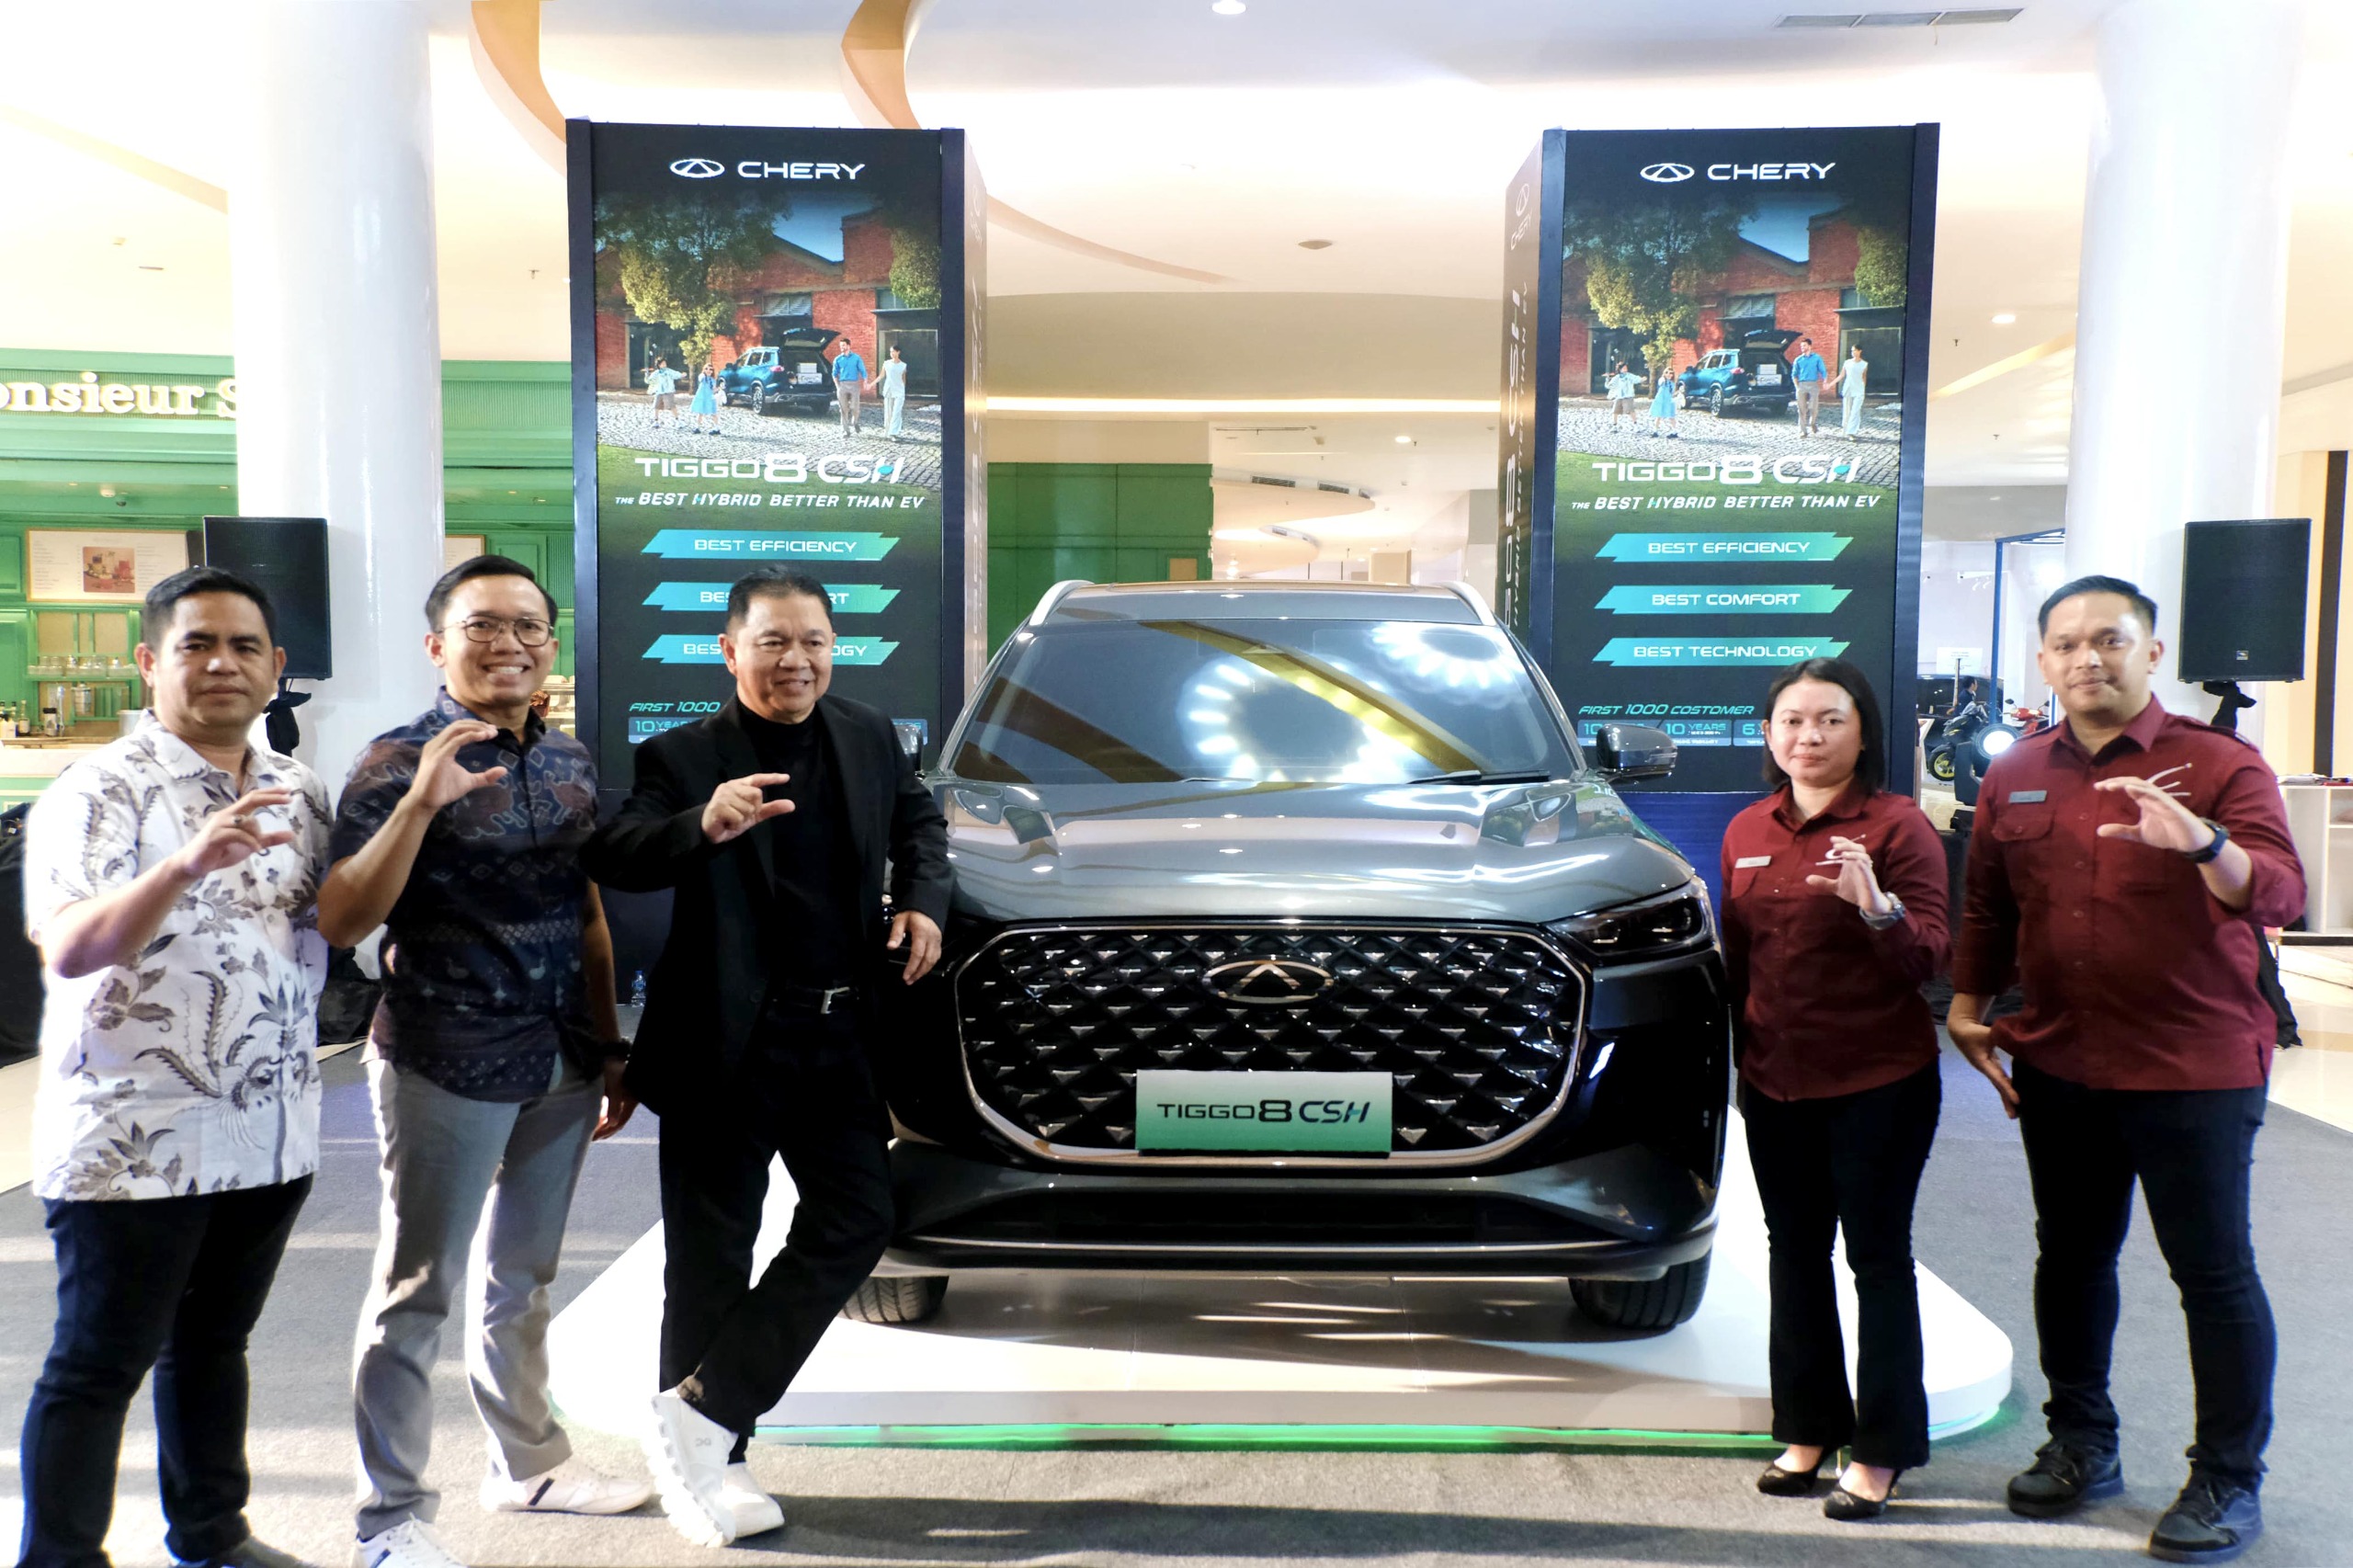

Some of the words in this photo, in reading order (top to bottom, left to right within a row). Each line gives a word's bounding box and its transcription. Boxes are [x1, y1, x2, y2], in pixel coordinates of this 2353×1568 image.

[737, 161, 866, 180] CHERY
[1707, 162, 1836, 180] CHERY
[1522, 281, 1528, 314] EV
[1508, 289, 1520, 437] CSH
[817, 454, 904, 484] CSH
[1772, 455, 1862, 484] CSH
[638, 493, 688, 506] BEST
[692, 493, 762, 506] HYBRID
[769, 494, 839, 507] BETTER
[847, 495, 895, 508] THAN
[900, 496, 925, 508] EV
[1594, 496, 1642, 509] BEST
[1647, 495, 1717, 508] HYBRID
[1723, 495, 1793, 508] BETTER
[1800, 495, 1848, 508] THAN
[1854, 494, 1881, 507] EV
[694, 540, 745, 551] BEST
[749, 540, 857, 552] EFFICIENCY
[1648, 542, 1699, 553] BEST
[1703, 541, 1810, 553] EFFICIENCY
[700, 591, 729, 603] BE
[1652, 594, 1701, 606] BEST
[1706, 593, 1801, 606] COMFORT
[683, 643, 722, 655] BES
[1633, 645, 1685, 657] BEST
[1688, 645, 1817, 657] TECHNOLOGY
[629, 702, 674, 712] FIRST
[676, 701, 722, 712] 1000
[1578, 705, 1623, 715] FIRST
[1625, 704, 1669, 715] 1000
[635, 720, 656, 733] 10
[1665, 723, 1685, 735] 10
[1688, 722, 1726, 731] YEARS
[1742, 723, 1756, 736] 6
[1299, 1100, 1370, 1123] CSH
